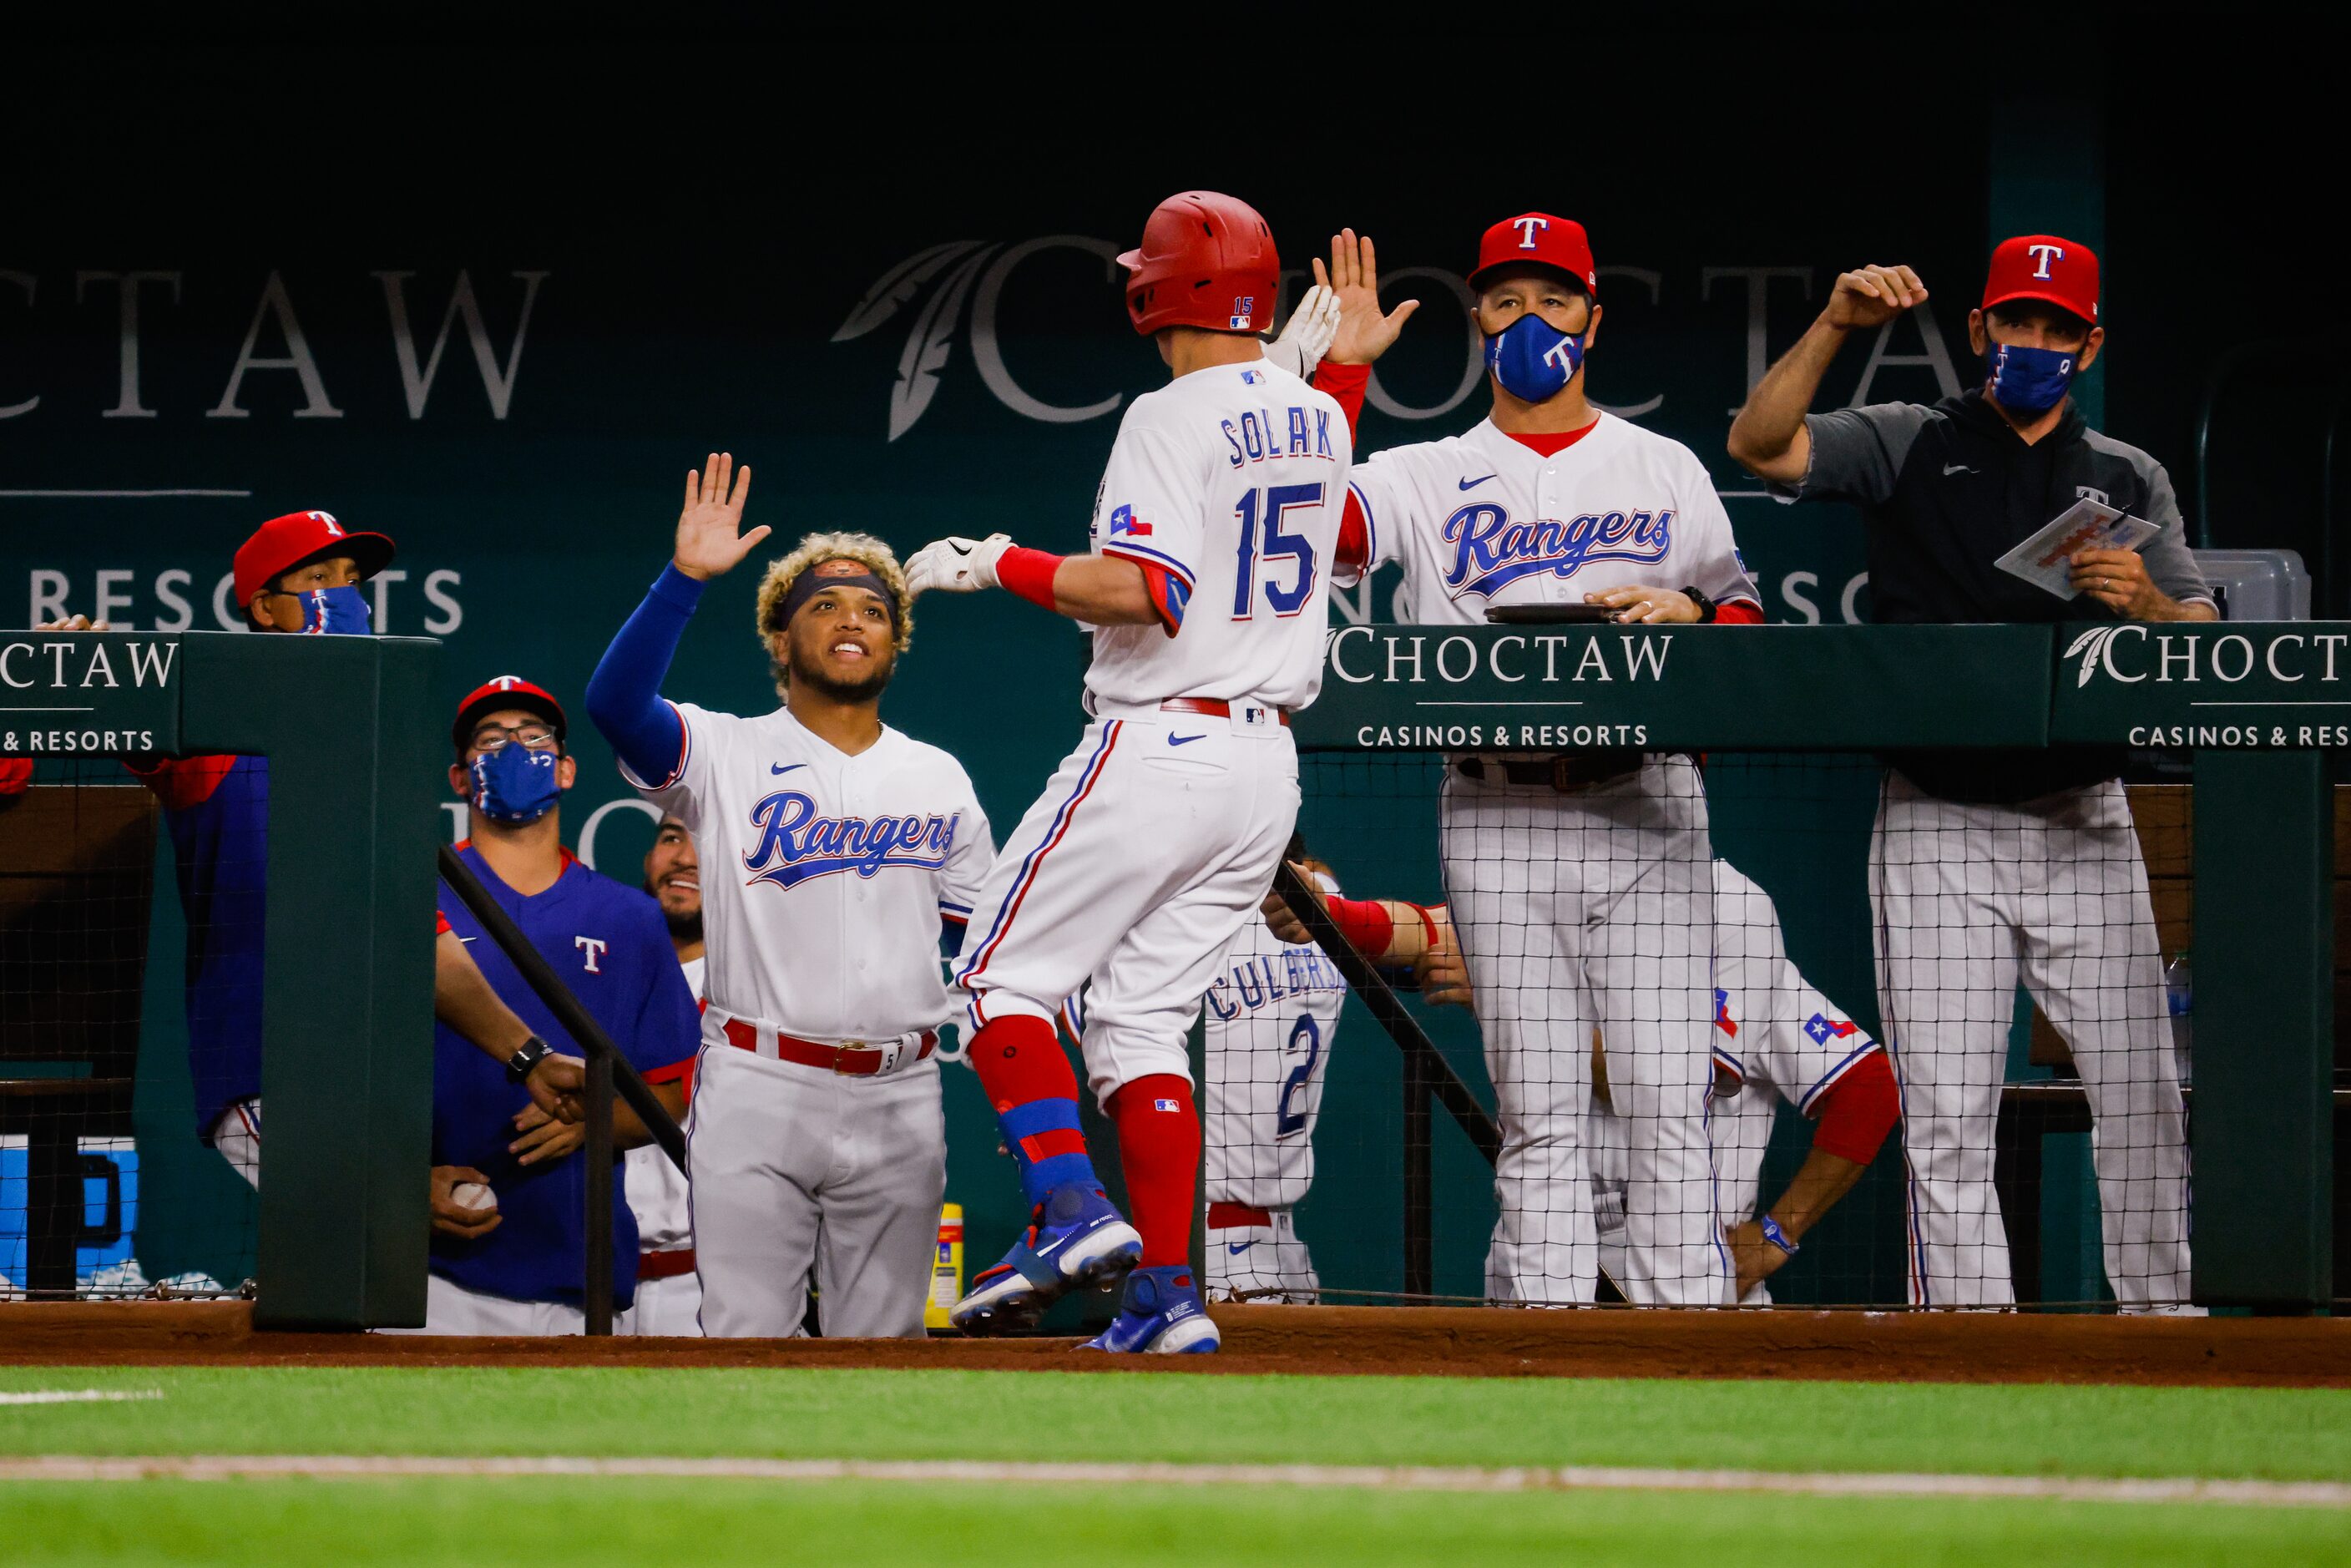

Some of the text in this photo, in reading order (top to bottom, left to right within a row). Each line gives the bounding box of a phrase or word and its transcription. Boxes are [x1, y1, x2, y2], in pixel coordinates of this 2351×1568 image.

[1234, 296, 1254, 315] 15
[1221, 407, 1335, 468] SOLAK
[1231, 481, 1327, 621] 15
[1443, 502, 1675, 599] Rangers
[1332, 626, 1674, 683] CHOCTAW
[2103, 625, 2348, 683] CHOCT
[3, 731, 152, 751] & RESORTS
[1358, 725, 1648, 746] CASINOS & RESORTS
[2129, 726, 2348, 746] CASINOS & RES
[742, 790, 961, 891] Rangers
[574, 935, 608, 974] T
[887, 1054, 894, 1070] 5
[1277, 1013, 1321, 1141] 2
